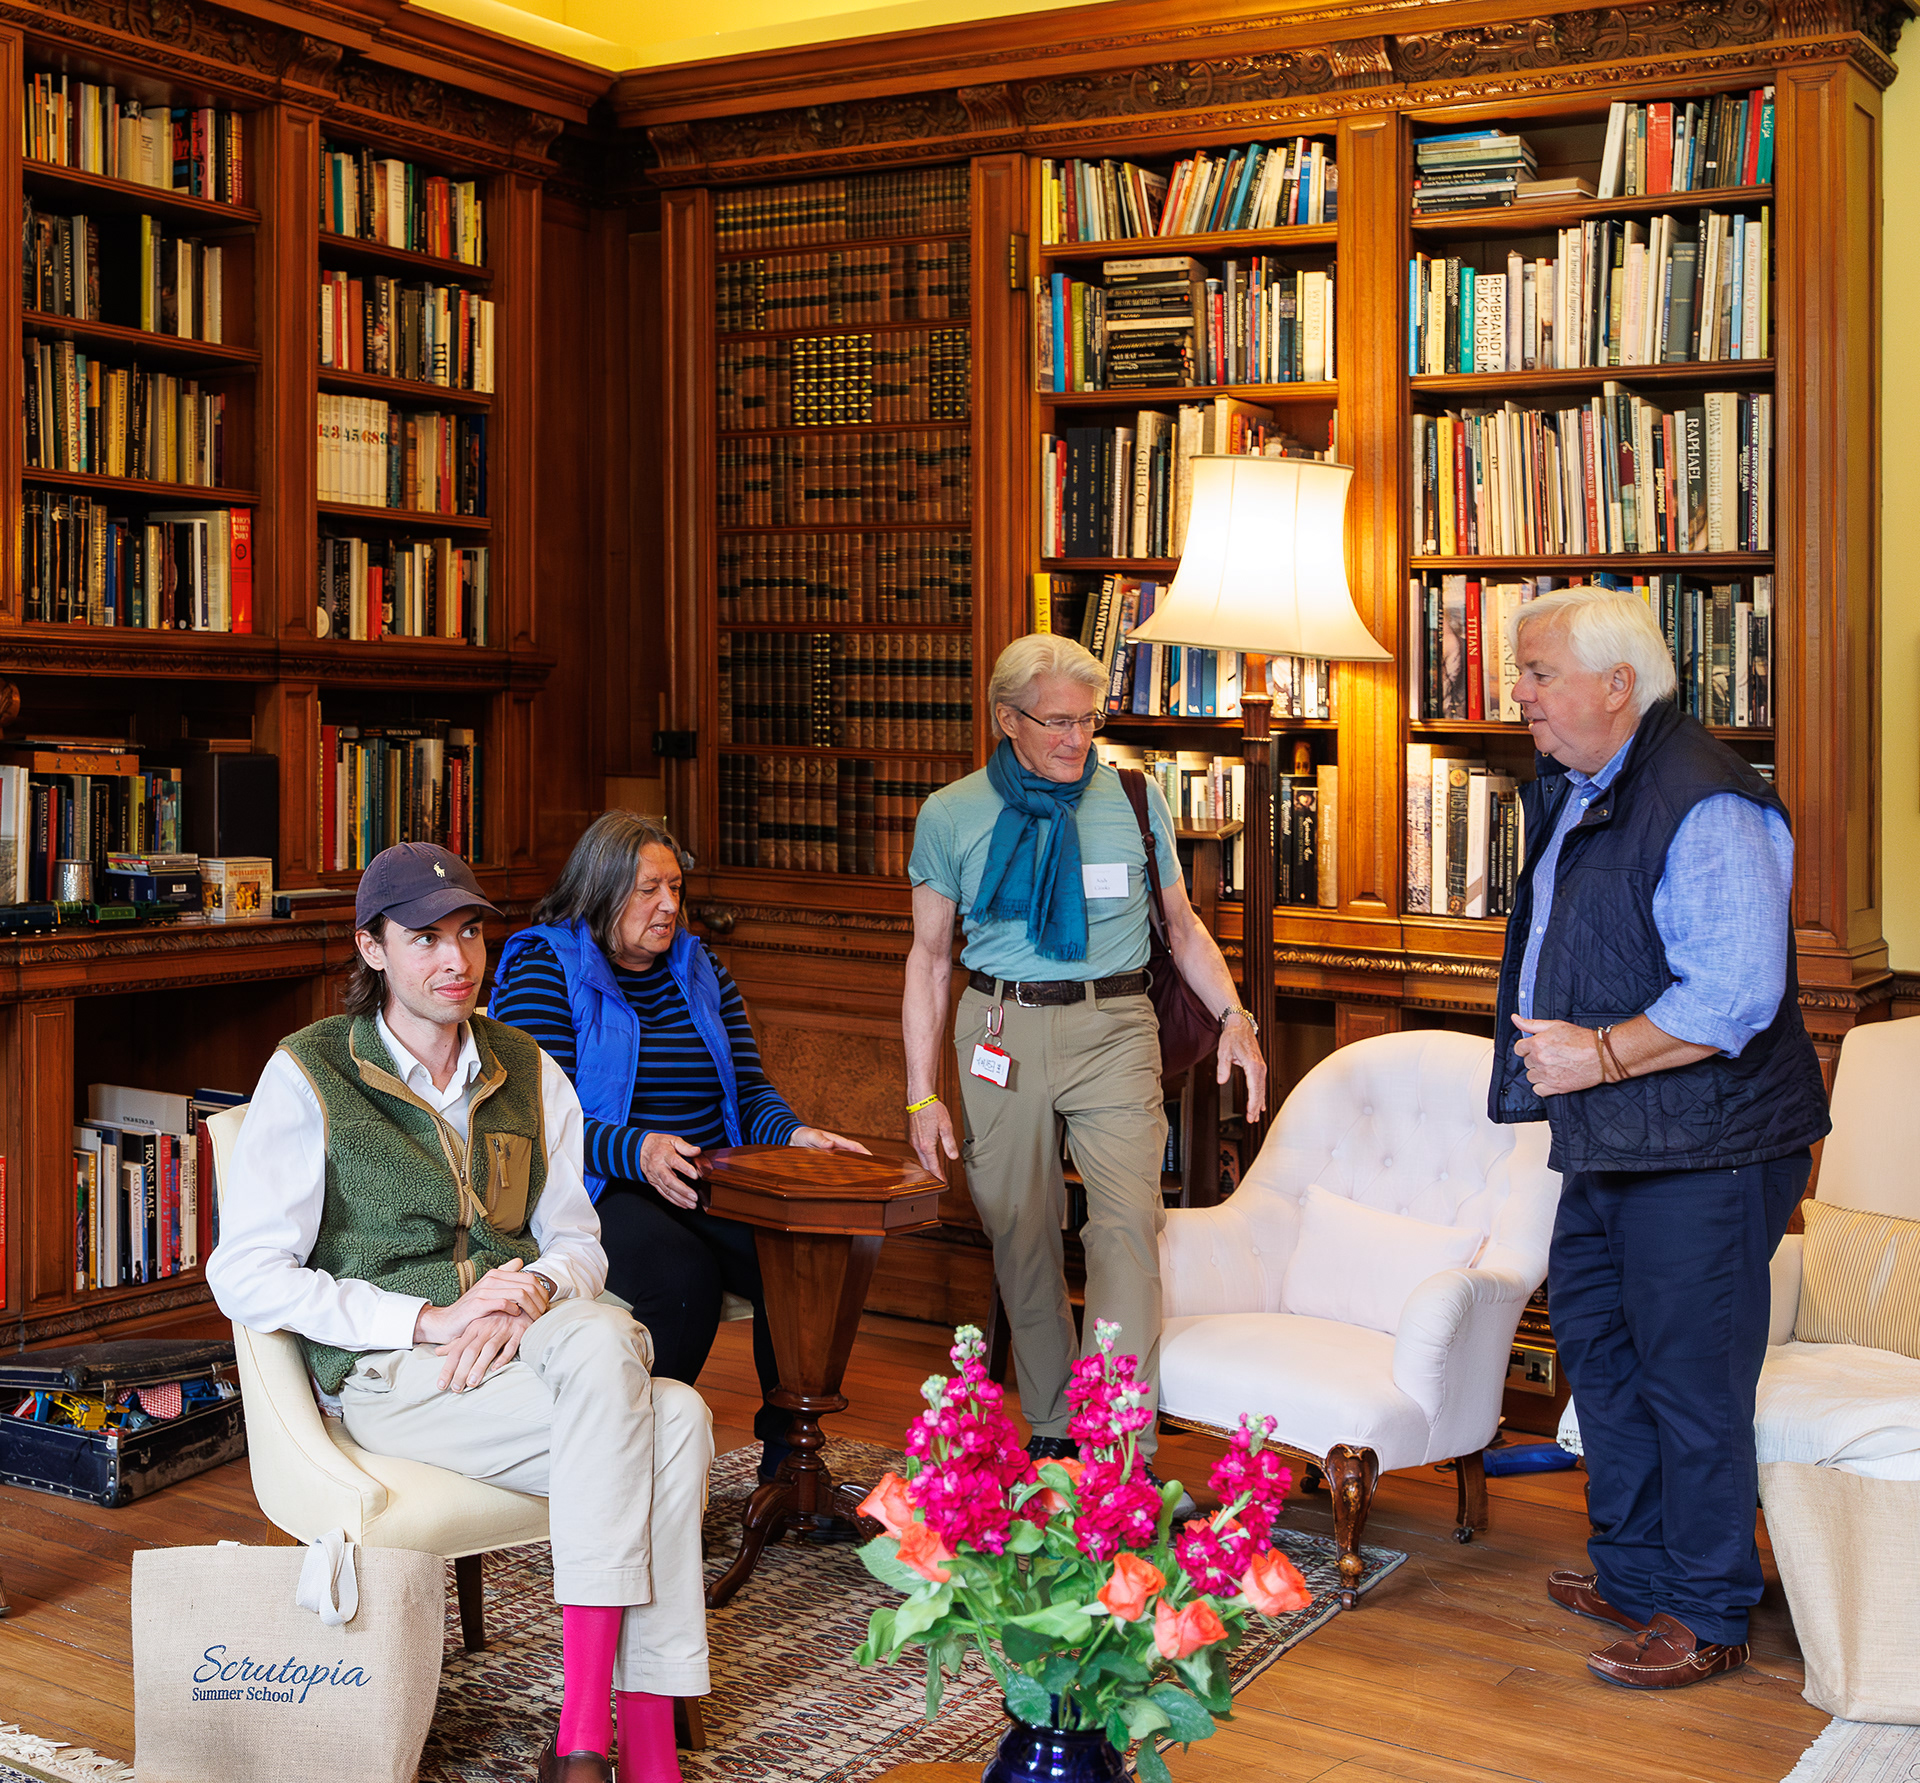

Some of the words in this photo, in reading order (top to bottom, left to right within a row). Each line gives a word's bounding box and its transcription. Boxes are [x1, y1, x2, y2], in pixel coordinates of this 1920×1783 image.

[1476, 278, 1489, 313] RIJKS
[1490, 278, 1502, 358] REMBRANDT
[1476, 316, 1489, 373] MUSEUM
[68, 371, 76, 404] SHOCK
[69, 404, 77, 418] OF
[1709, 398, 1720, 435] JAPAN
[318, 424, 323, 437] 1
[331, 425, 340, 440] 3
[351, 429, 359, 442] 5
[380, 432, 388, 446] 9
[70, 439, 78, 464] NEW
[1687, 418, 1701, 484] RAPHAEL
[1135, 450, 1148, 514] GREECE
[1092, 580, 1114, 650] ROMANTICISM
[1467, 616, 1478, 656] TITIAN
[1115, 650, 1127, 671] FROM
[1111, 671, 1125, 697] RUSSIA
[1434, 773, 1443, 828] VERMEER
[1281, 800, 1292, 836] Rembrandt
[229, 869, 269, 878] SCHUBERT
[90, 1158, 96, 1167] IN
[144, 1144, 154, 1183] FRANS
[90, 1201, 96, 1211] OF
[133, 1172, 141, 1206] GOYA
[145, 1185, 155, 1219] HALS
[192, 1644, 372, 1704] Scrutopia
[192, 1687, 244, 1702] Summer
[246, 1686, 294, 1703] School
